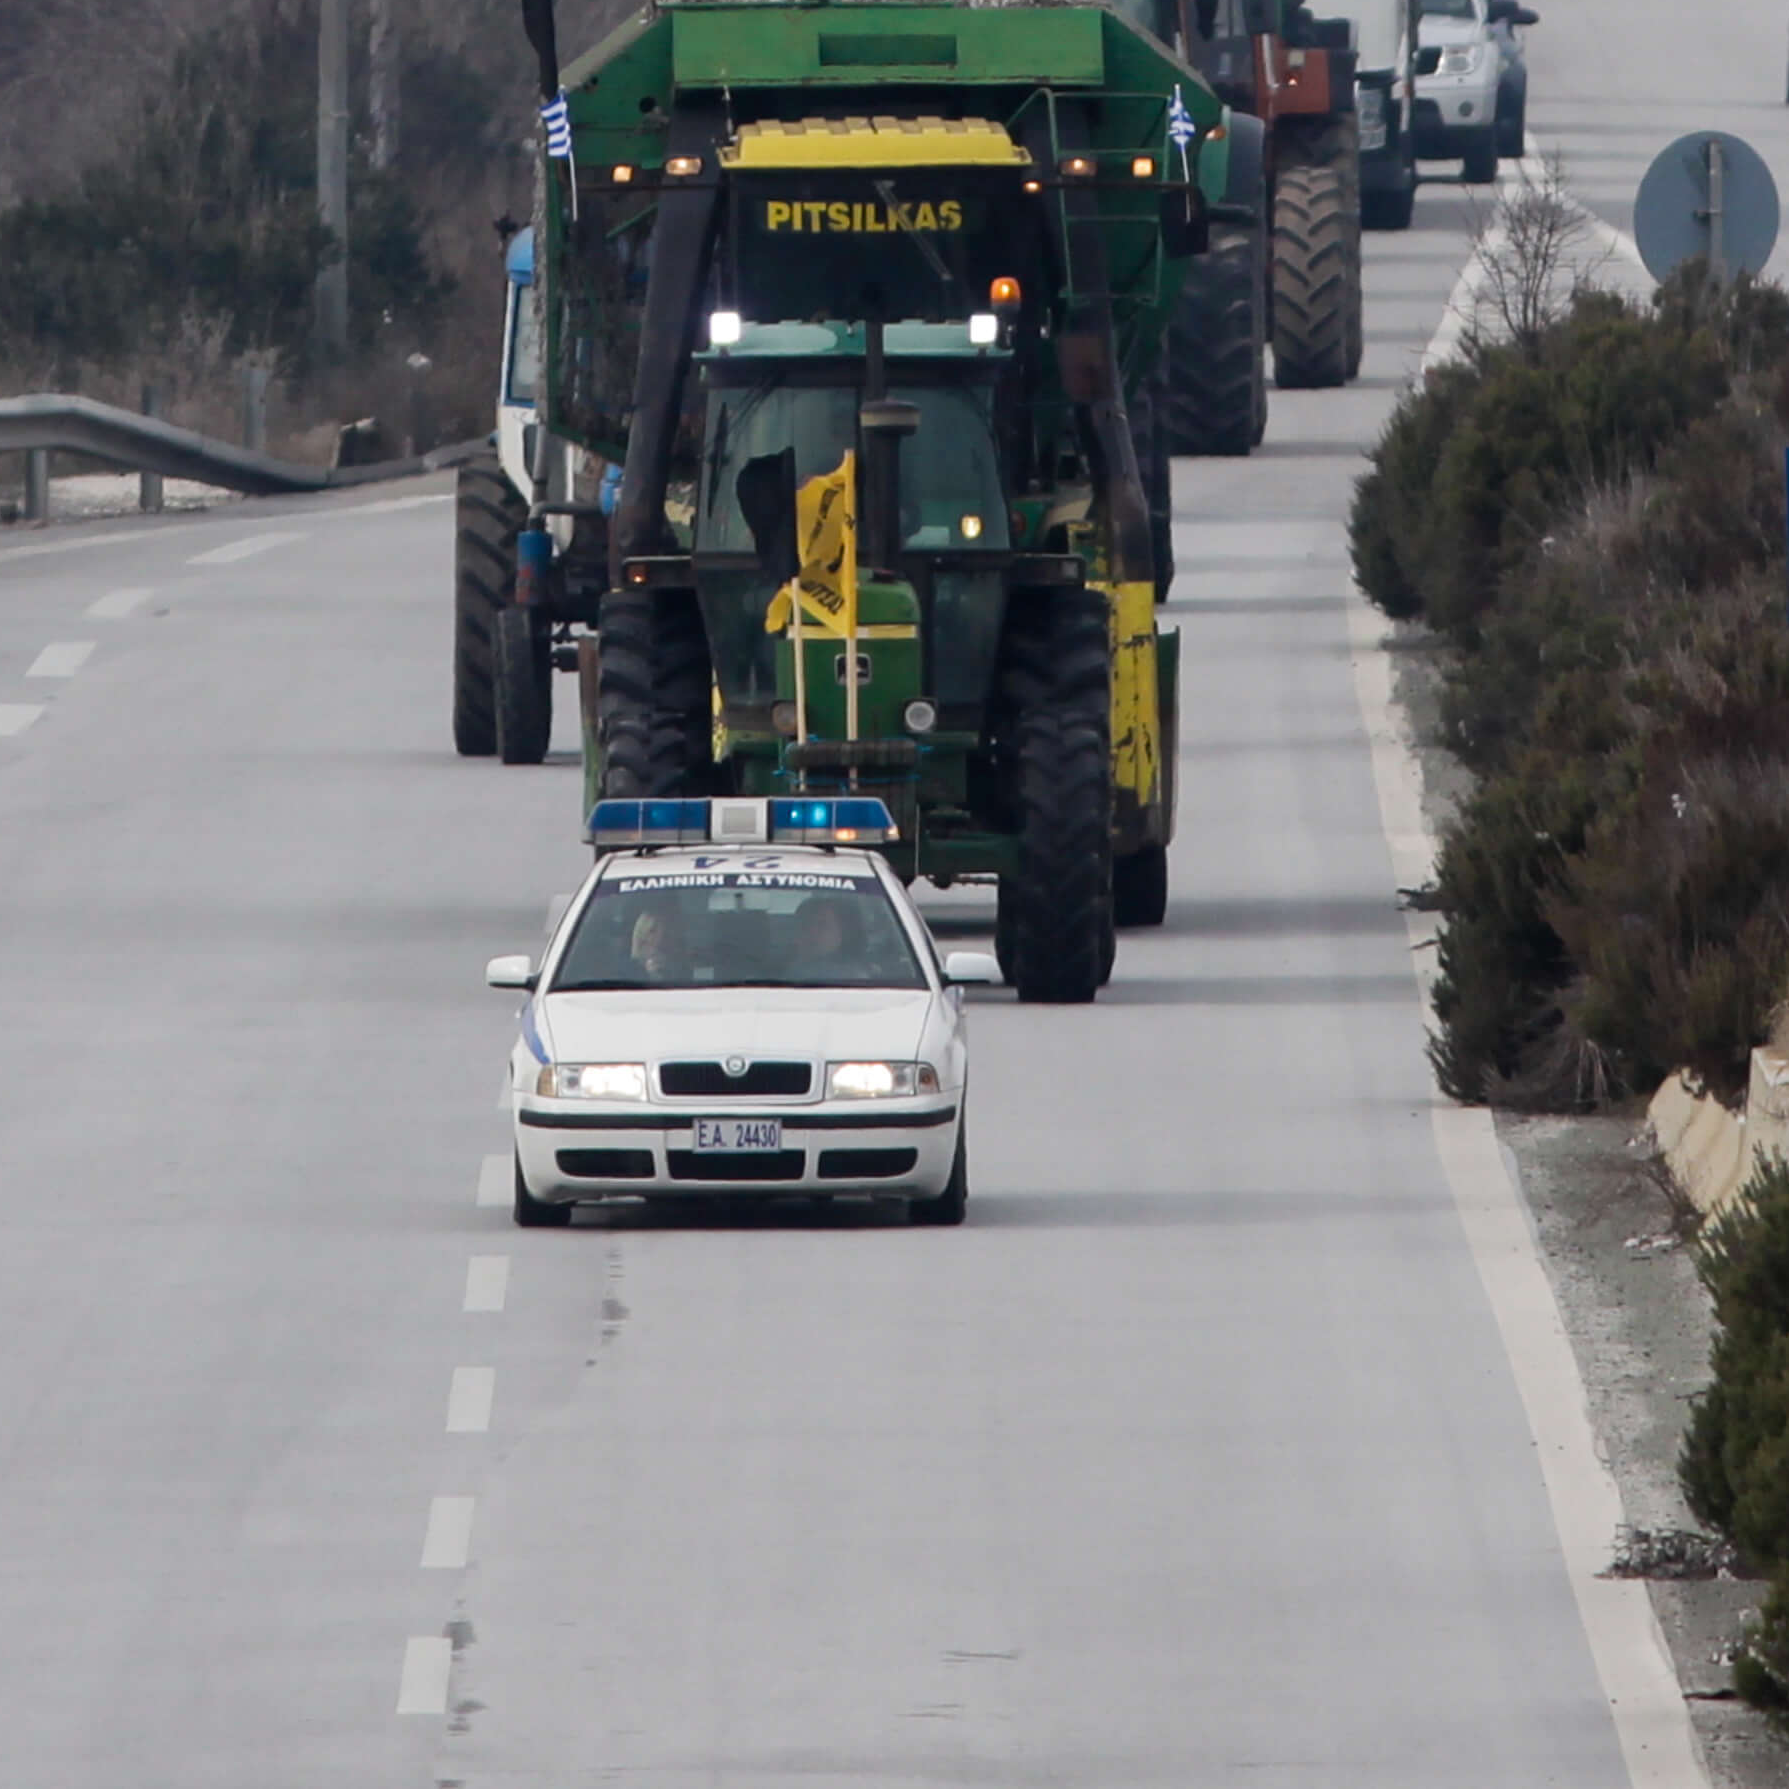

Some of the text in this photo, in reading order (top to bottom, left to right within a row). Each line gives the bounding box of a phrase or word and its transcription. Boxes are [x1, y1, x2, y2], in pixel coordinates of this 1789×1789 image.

[767, 200, 963, 233] PITSILKAS
[619, 874, 857, 893] ΕΛΛΗΝΙΚΗ ΑΣΤΥΝΟΜΙΑ
[735, 1123, 777, 1148] 24430
